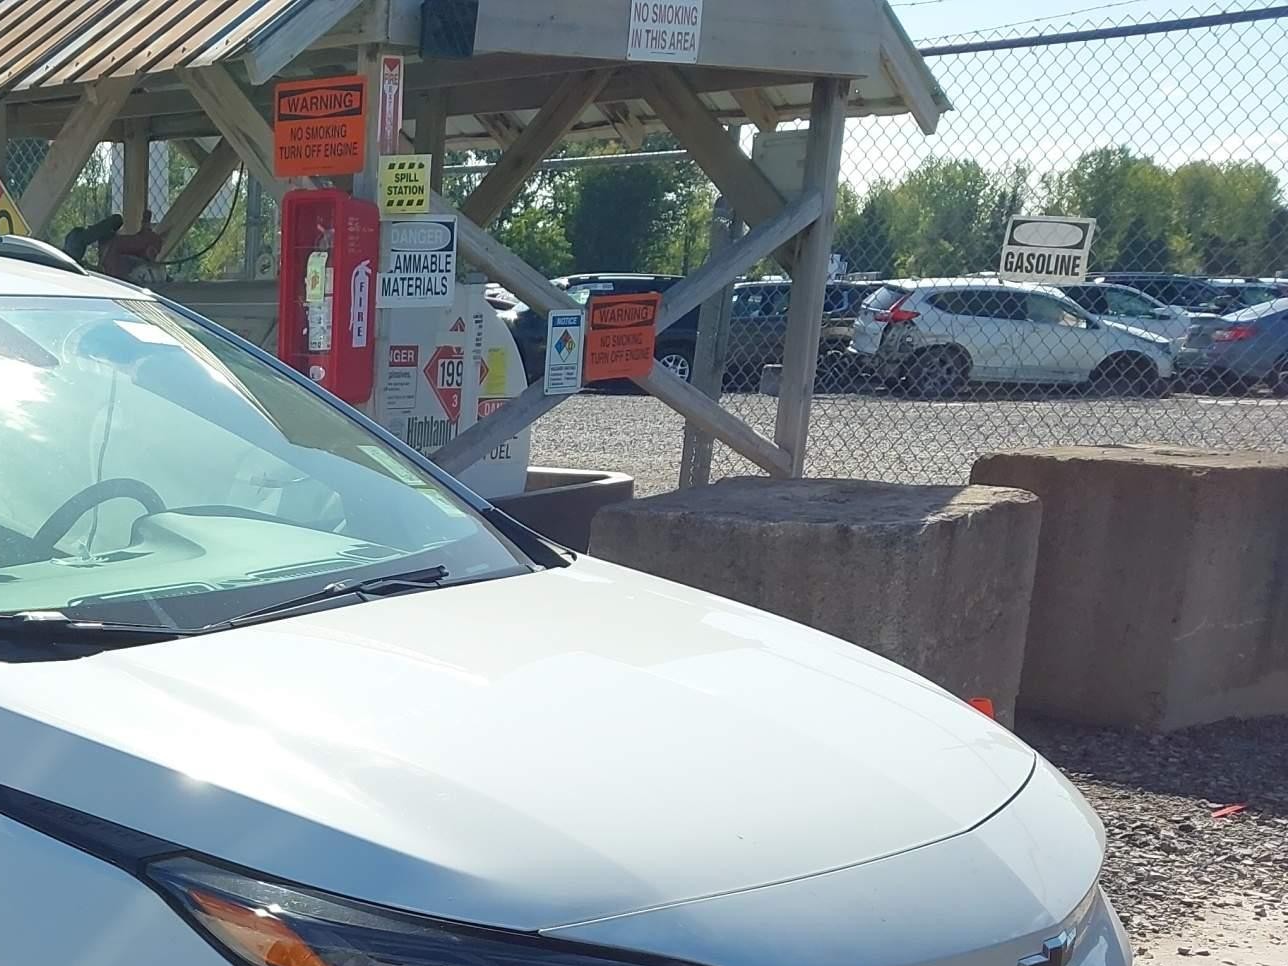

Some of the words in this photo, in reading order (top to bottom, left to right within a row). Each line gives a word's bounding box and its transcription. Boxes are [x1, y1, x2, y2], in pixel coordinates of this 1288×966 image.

[634, 2, 649, 22] NO
[652, 3, 698, 26] SMOKING
[631, 28, 643, 49] IN
[645, 28, 668, 50] THIS
[669, 31, 696, 51] AREA
[288, 92, 354, 113] WARNING
[291, 126, 304, 141] NO
[305, 124, 347, 140] SMOKING
[279, 145, 303, 161] TURN
[305, 143, 322, 158] OFF
[324, 141, 359, 158] ENGINE
[394, 173, 419, 183] SPILL
[387, 185, 424, 196] STATION
[388, 254, 452, 273] AMMABLE
[1004, 251, 1082, 277] GASOLINE
[381, 276, 448, 297] MATERIALS
[599, 307, 648, 322] WARNING
[600, 336, 610, 348] NO
[612, 333, 643, 347] SMOKING
[592, 351, 612, 365] TURN
[612, 350, 624, 363] OFF
[625, 348, 651, 362] ENGINE
[440, 360, 464, 387] 199
[452, 393, 458, 408] 3
[483, 442, 511, 460] UEL
